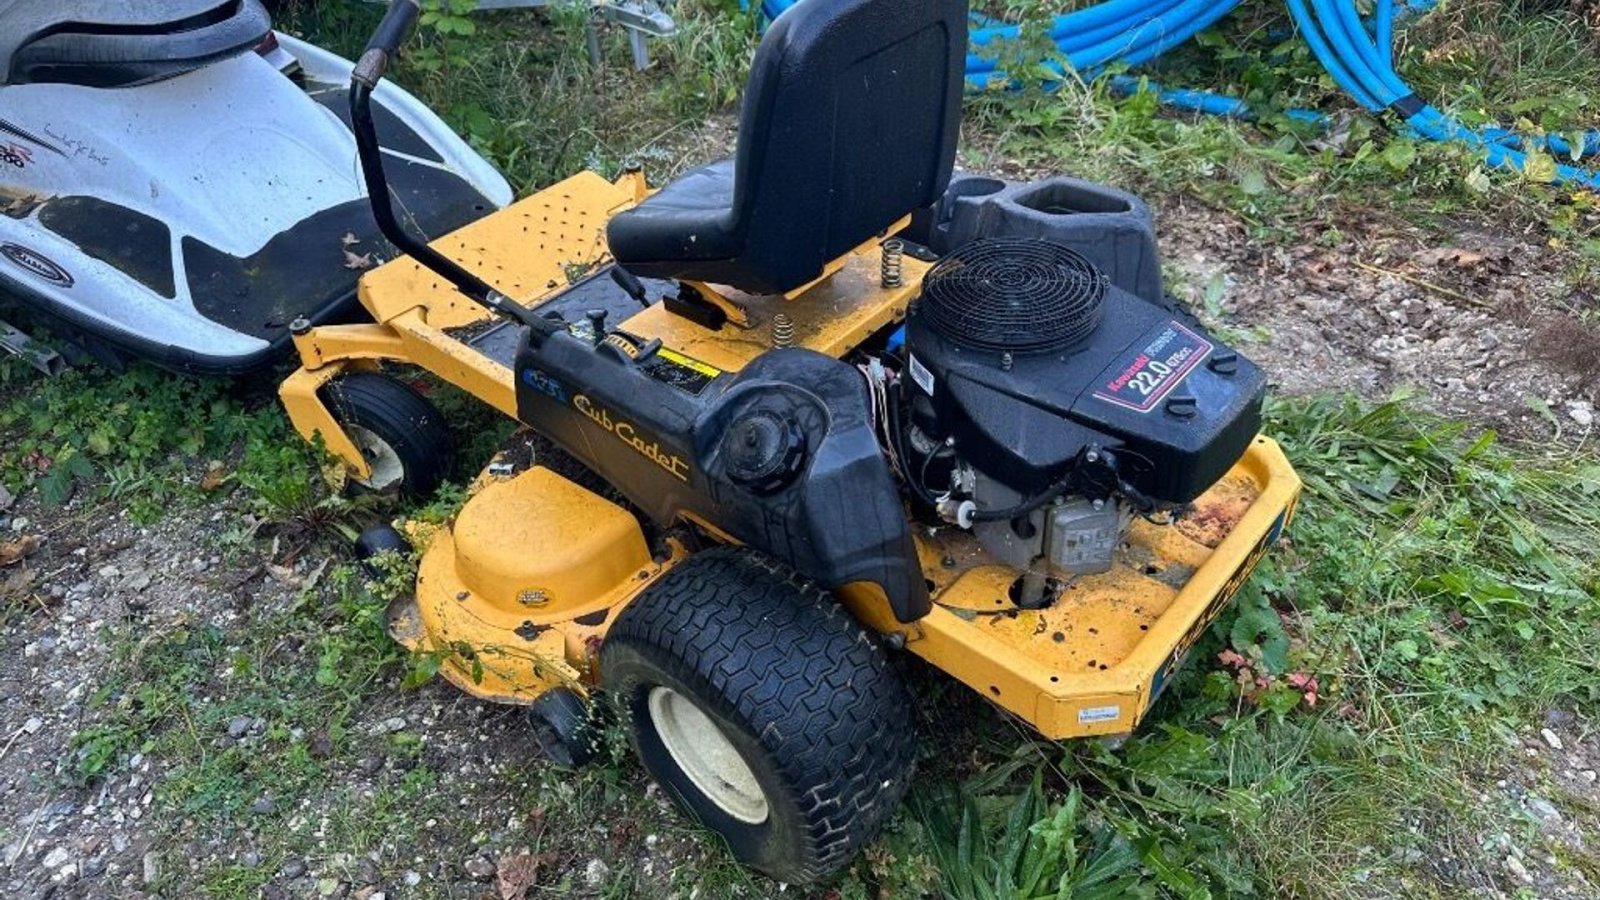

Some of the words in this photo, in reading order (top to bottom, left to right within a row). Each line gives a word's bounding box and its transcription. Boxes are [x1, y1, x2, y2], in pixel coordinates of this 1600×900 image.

[1128, 361, 1172, 395] 22.0
[573, 394, 613, 432] Cub
[615, 424, 689, 482] Cadet
